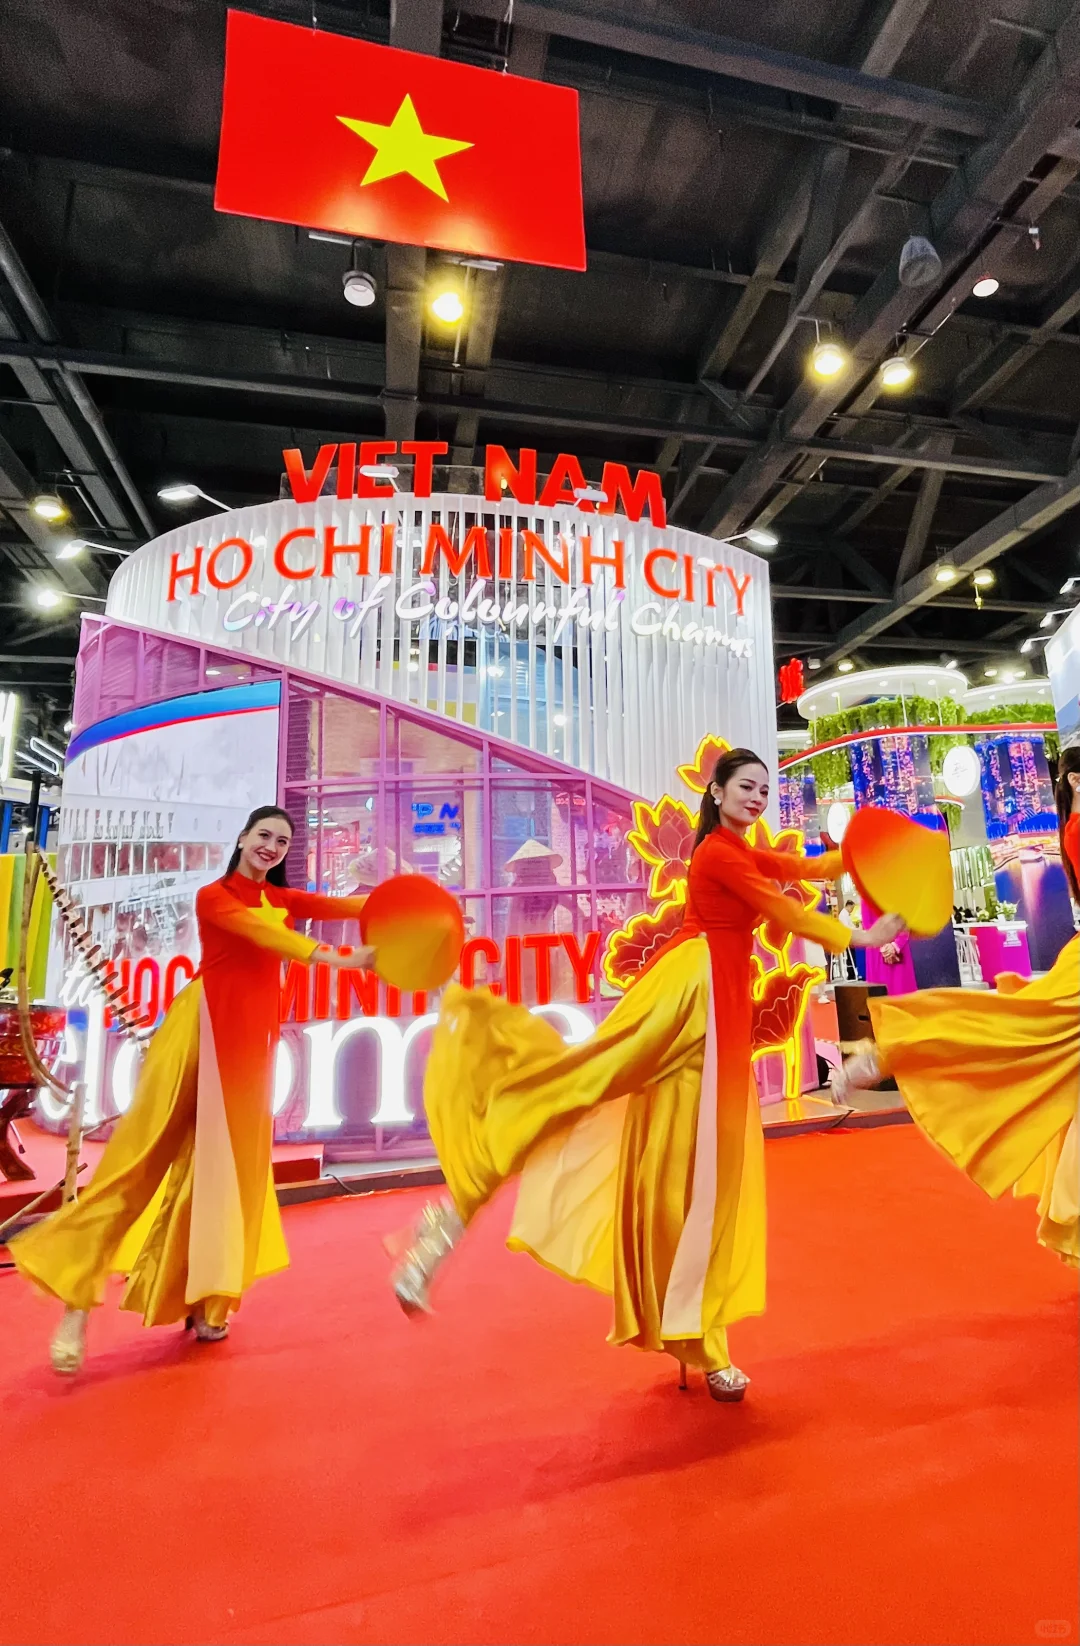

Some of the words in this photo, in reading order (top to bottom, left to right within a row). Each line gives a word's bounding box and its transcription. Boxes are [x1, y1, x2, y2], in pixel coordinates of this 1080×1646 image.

[282, 440, 448, 503] VIET
[485, 443, 667, 529] NAM
[167, 537, 253, 602] HO
[273, 524, 394, 580] CHI
[418, 523, 626, 589] MINH
[643, 548, 752, 616] CITY
[223, 583, 321, 642] City
[333, 575, 386, 638] of
[395, 578, 626, 643] Colourful
[631, 601, 755, 658] Charms
[459, 931, 601, 1006] CITY
